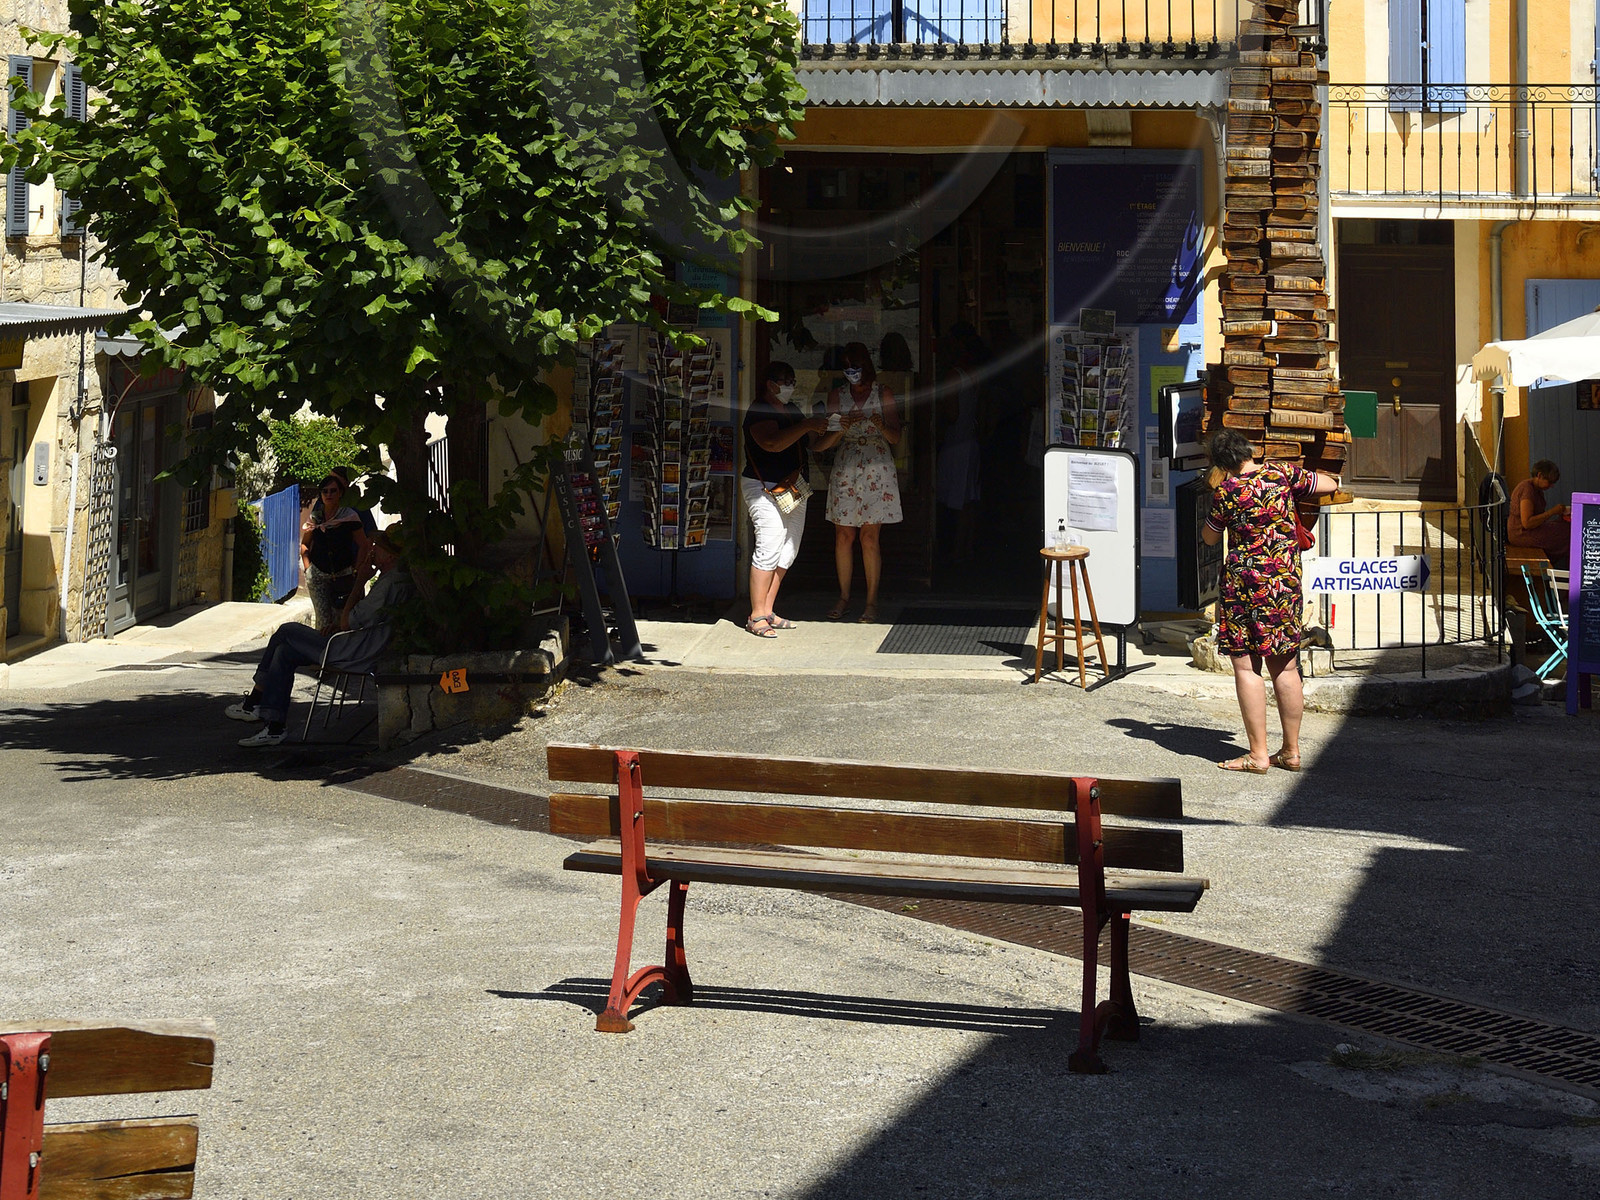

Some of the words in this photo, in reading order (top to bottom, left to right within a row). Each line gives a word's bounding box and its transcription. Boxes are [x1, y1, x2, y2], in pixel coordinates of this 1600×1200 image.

[1057, 242, 1101, 252] BIENVENUE
[1339, 560, 1398, 574] GLACES
[1311, 575, 1418, 591] ARTISANALES
